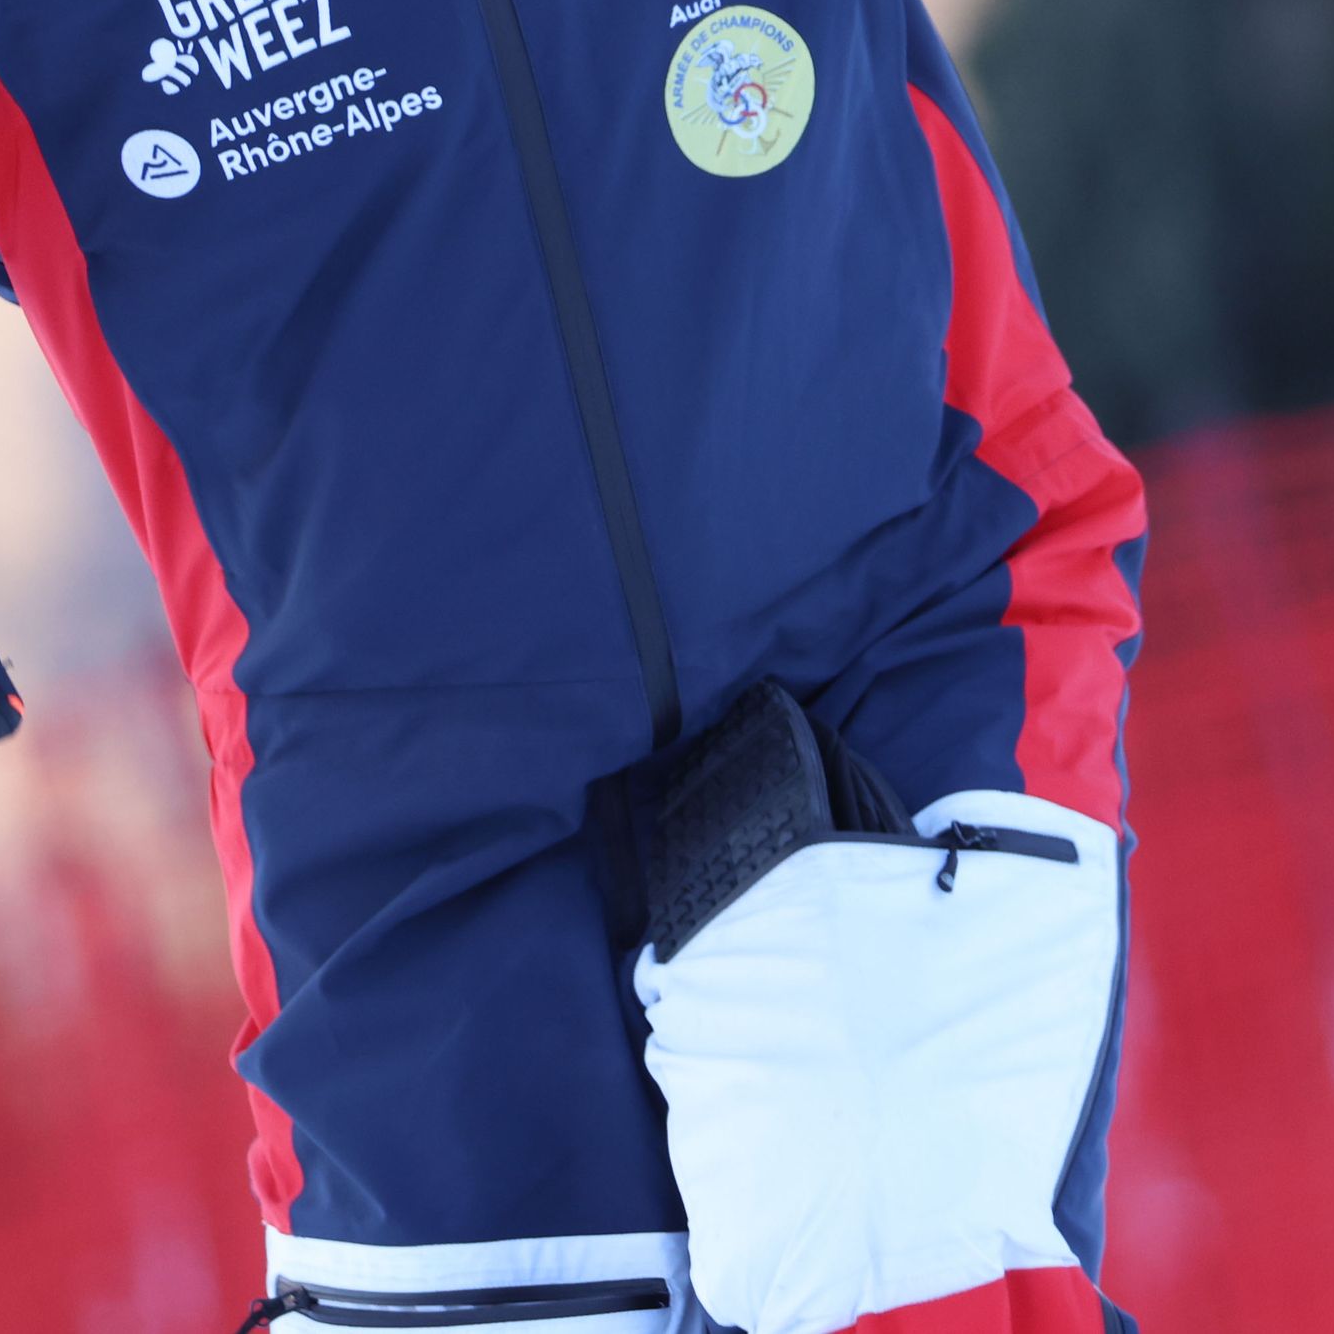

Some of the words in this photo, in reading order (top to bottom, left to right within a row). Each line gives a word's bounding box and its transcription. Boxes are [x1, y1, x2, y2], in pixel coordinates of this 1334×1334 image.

[690, 30, 709, 51] DE
[710, 15, 795, 54] CHAMPIONS
[210, 66, 387, 148] Auvergne-
[217, 86, 443, 181] Rhône-Alpes
